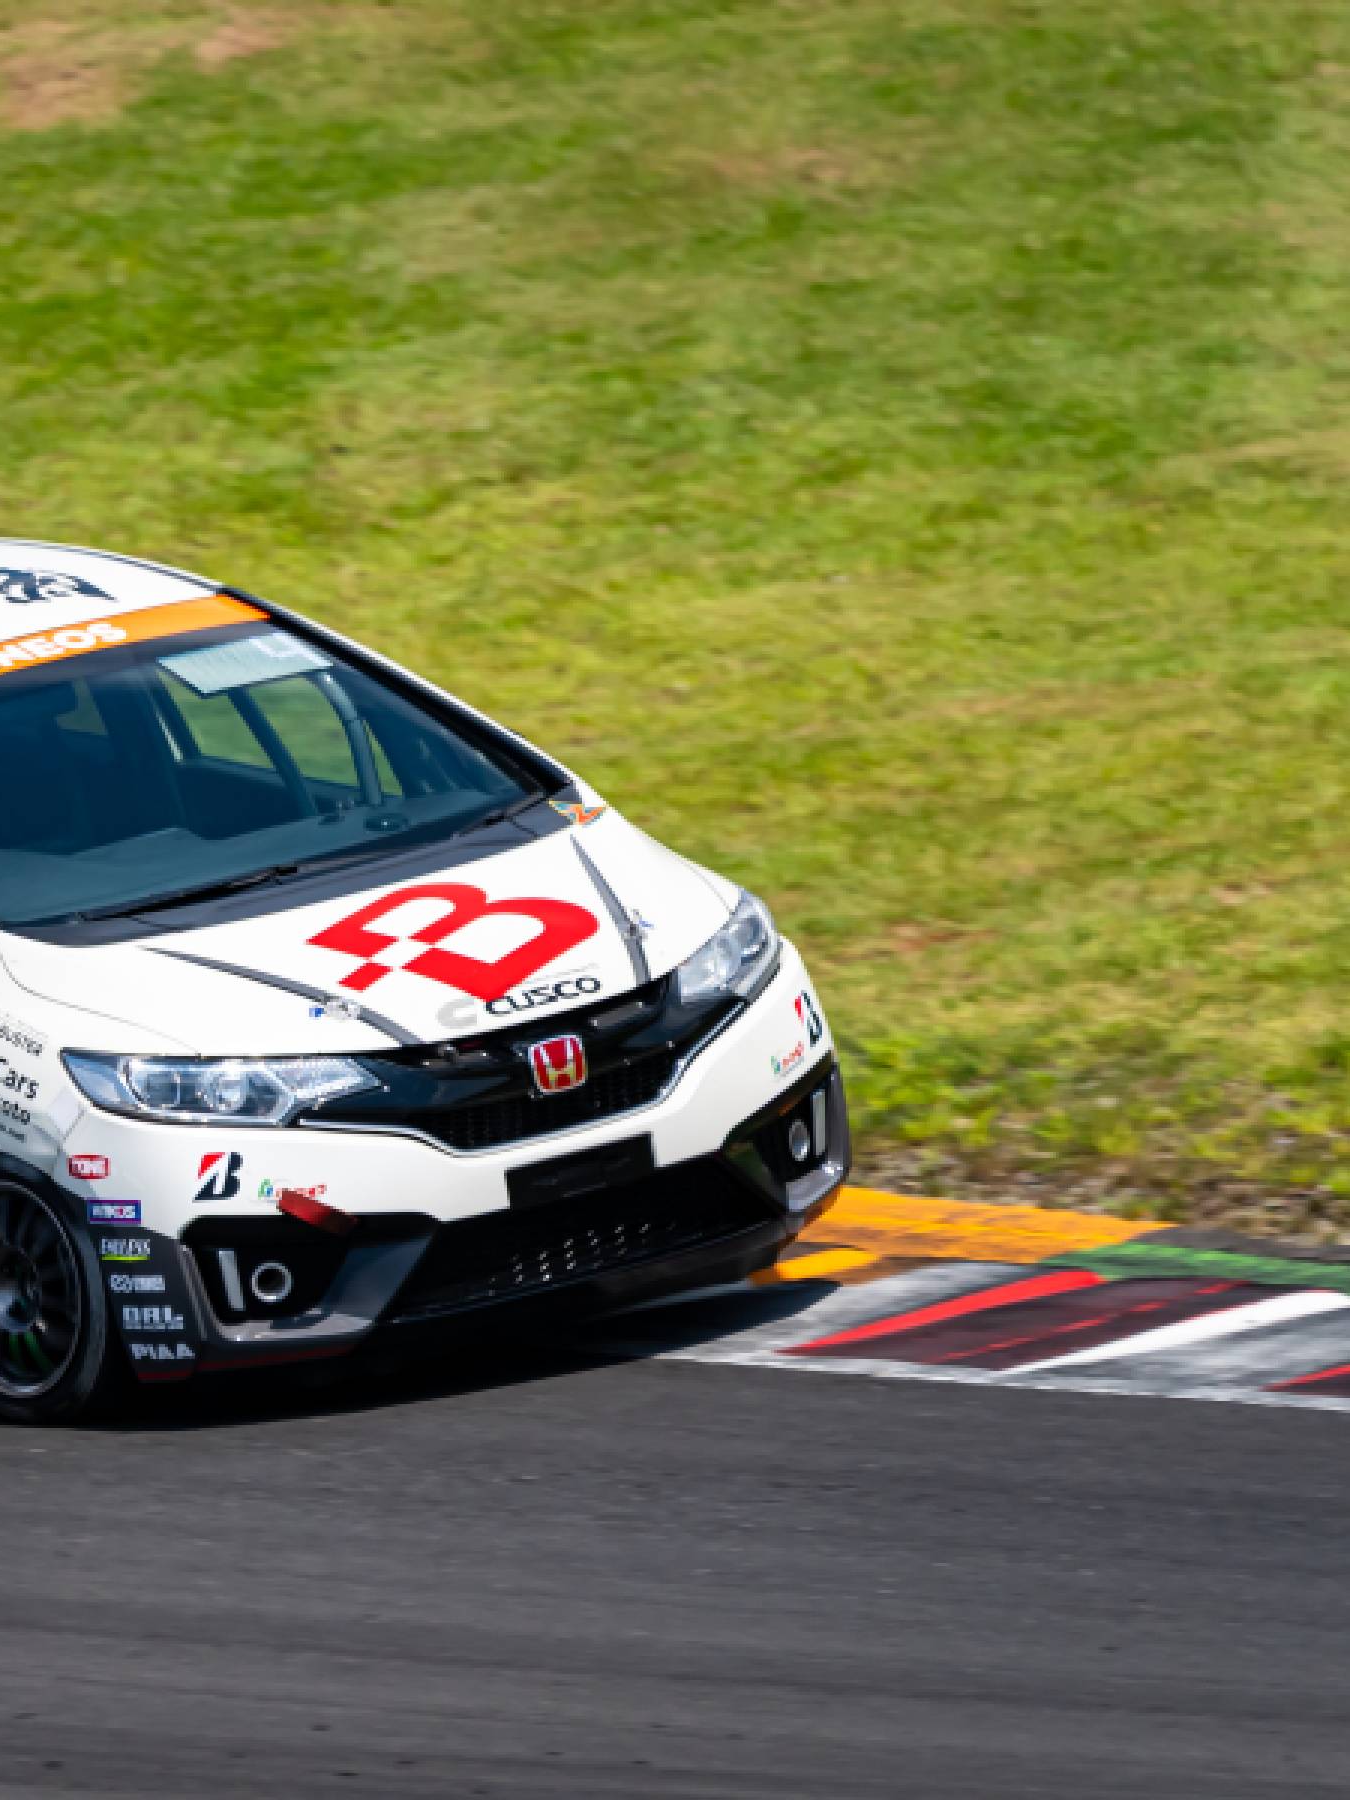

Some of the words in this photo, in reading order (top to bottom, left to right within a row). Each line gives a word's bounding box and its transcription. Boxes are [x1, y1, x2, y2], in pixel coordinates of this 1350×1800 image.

[485, 976, 602, 1017] CUSCO
[69, 1157, 110, 1177] TONE
[130, 1343, 196, 1361] PIAA
